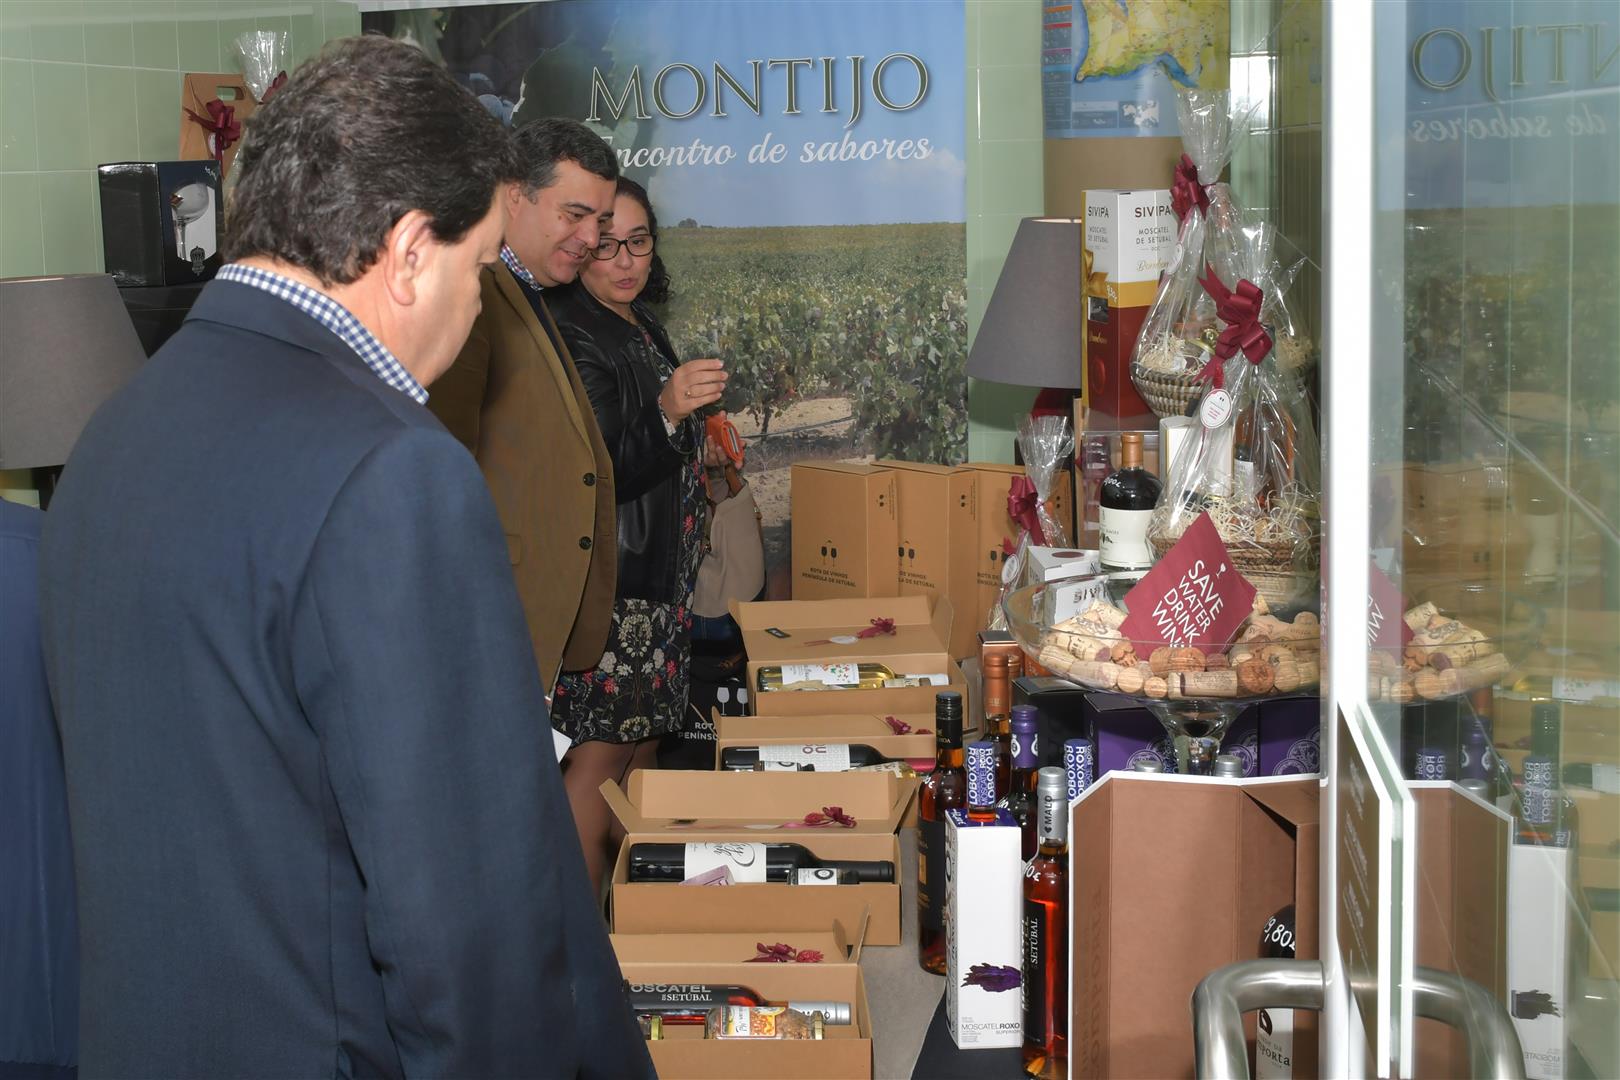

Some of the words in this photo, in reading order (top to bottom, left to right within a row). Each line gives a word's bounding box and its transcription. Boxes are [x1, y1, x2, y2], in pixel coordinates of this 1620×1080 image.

[586, 52, 929, 129] MONTIJO
[747, 132, 788, 165] de
[799, 131, 933, 164] sabores
[1088, 206, 1109, 218] SIVIPA
[1135, 205, 1171, 218] SIVIPA
[1136, 237, 1145, 245] DE
[1138, 226, 1169, 235] MOSCATEL
[1188, 560, 1223, 620] SAVE
[1163, 588, 1200, 643] DRINK
[1179, 575, 1210, 633] WATER
[1030, 917, 1038, 964] SETÚBAL
[630, 985, 712, 993] OSCATEL
[666, 992, 712, 1001] SETÚBAL
